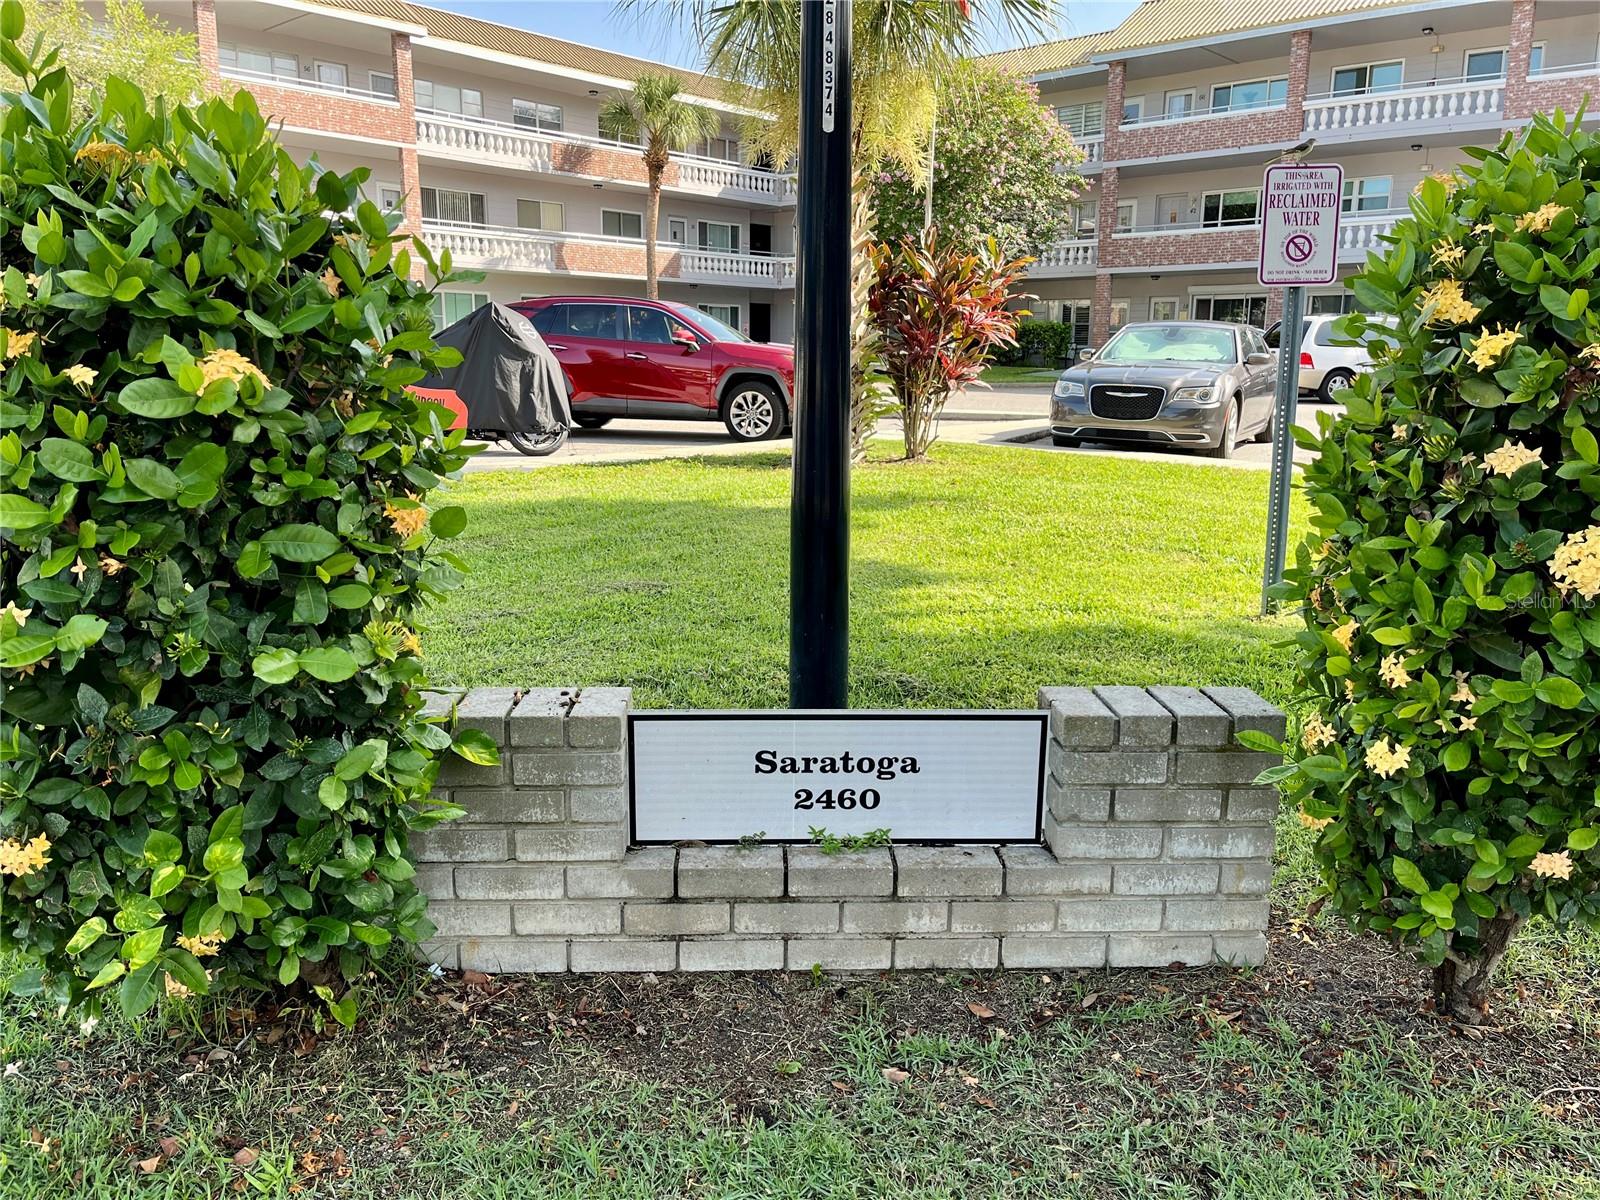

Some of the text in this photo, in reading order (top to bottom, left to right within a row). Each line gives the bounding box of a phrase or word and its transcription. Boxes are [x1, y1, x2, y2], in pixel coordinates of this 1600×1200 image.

[1285, 171, 1324, 180] THIS AREA
[1273, 181, 1333, 191] IRRIGATED WITH
[1269, 192, 1336, 209] RECLAIMED
[1282, 211, 1320, 226] WATER
[754, 750, 921, 780] Saratoga
[794, 788, 881, 810] 2460
